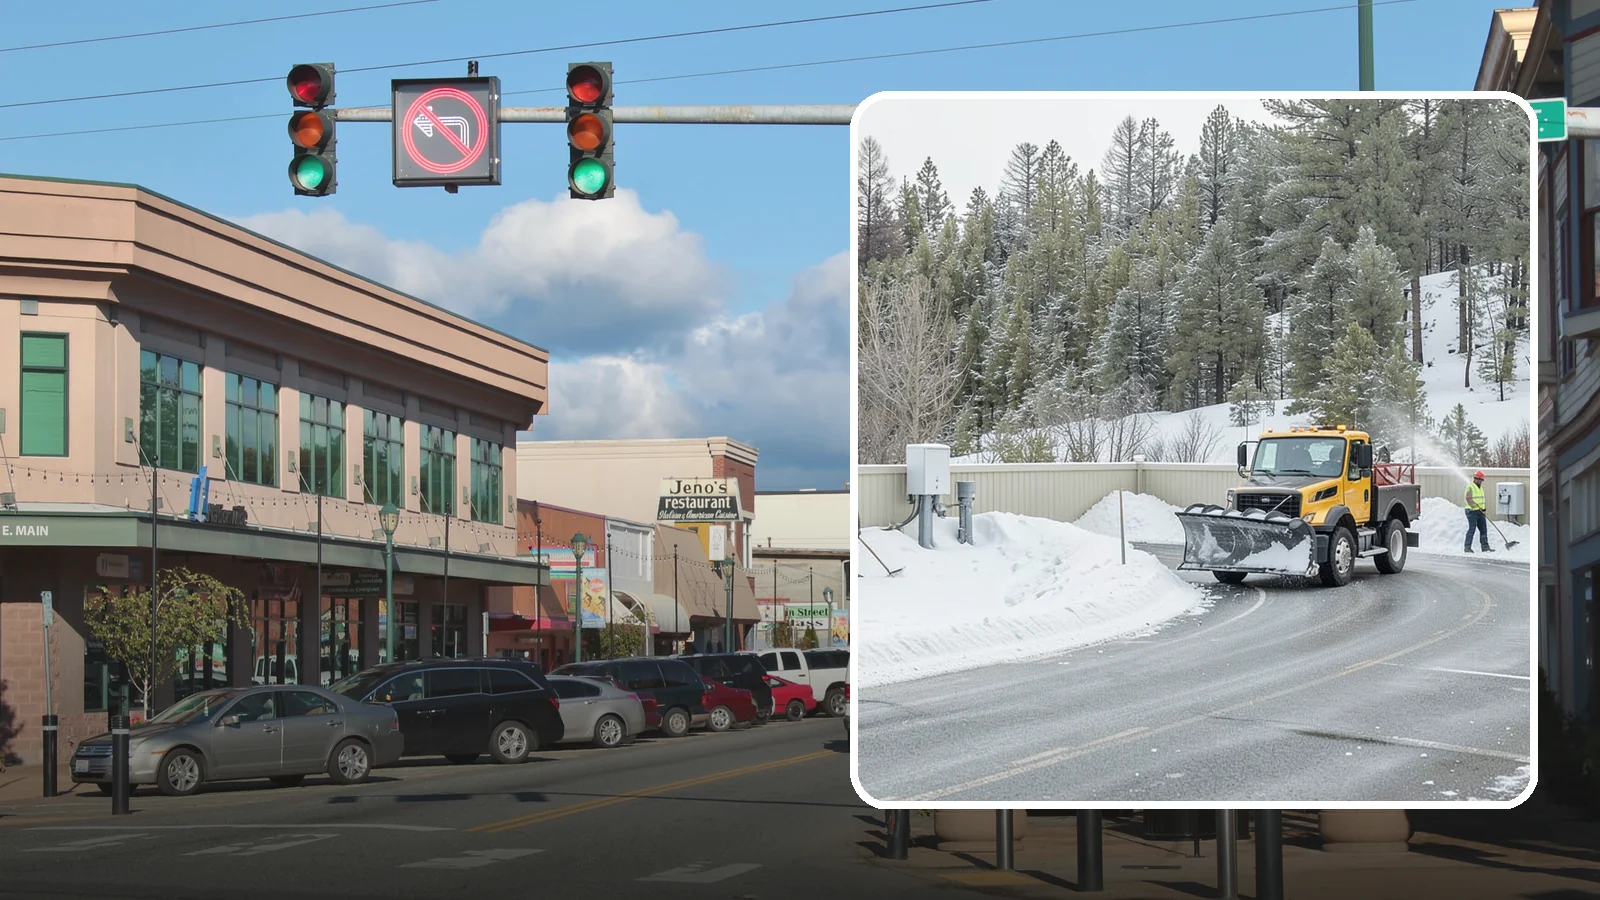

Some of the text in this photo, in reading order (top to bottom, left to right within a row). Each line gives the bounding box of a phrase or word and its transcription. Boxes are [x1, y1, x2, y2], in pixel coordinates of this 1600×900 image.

[670, 480, 727, 494] Jeno's
[665, 496, 731, 509] restaurant
[659, 511, 681, 519] Italian
[686, 510, 714, 519] American
[715, 510, 737, 519] Cuisine
[2, 525, 49, 536] E. MAIN
[797, 607, 829, 617] Street
[791, 618, 824, 627] lass
